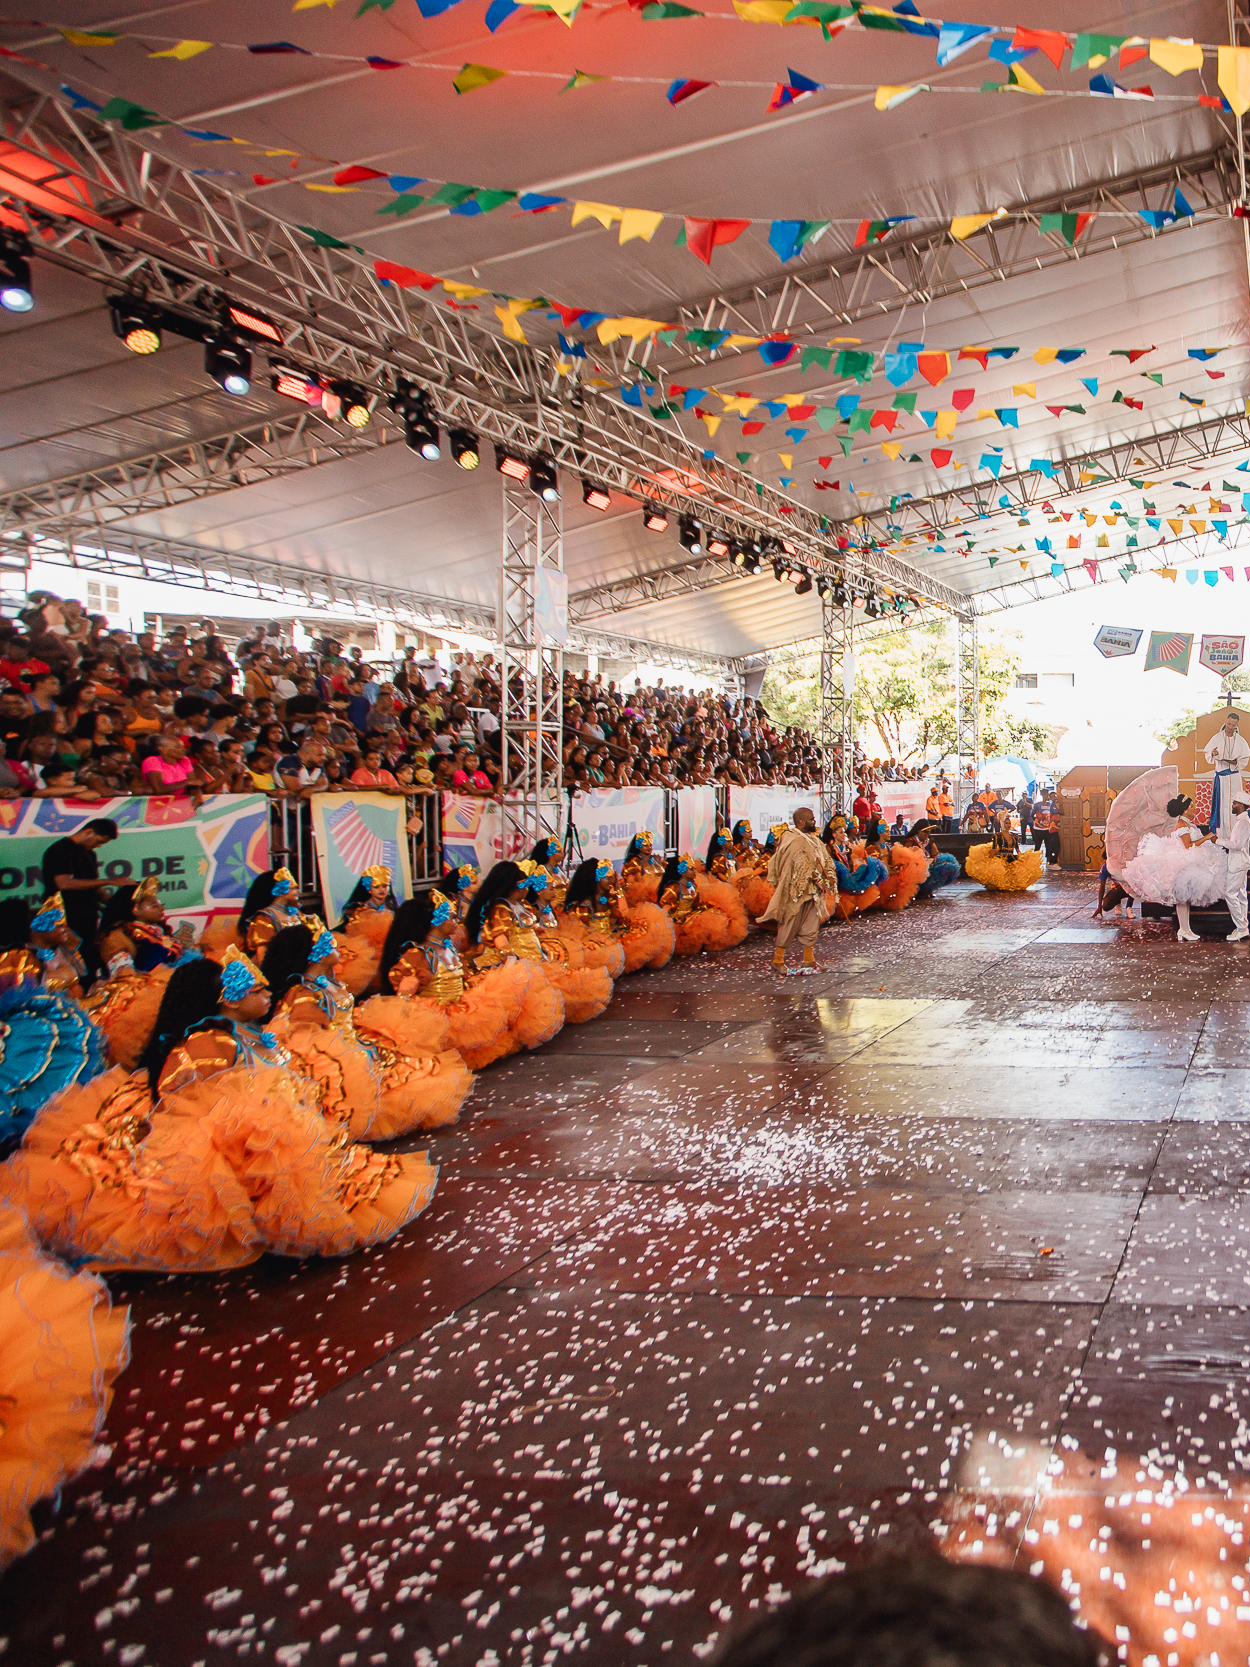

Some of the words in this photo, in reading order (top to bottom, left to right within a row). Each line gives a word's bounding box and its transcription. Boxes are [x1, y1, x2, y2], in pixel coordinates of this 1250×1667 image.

[1211, 640, 1239, 649] SÃO
[598, 821, 637, 846] BAHIA
[142, 855, 185, 877] DE
